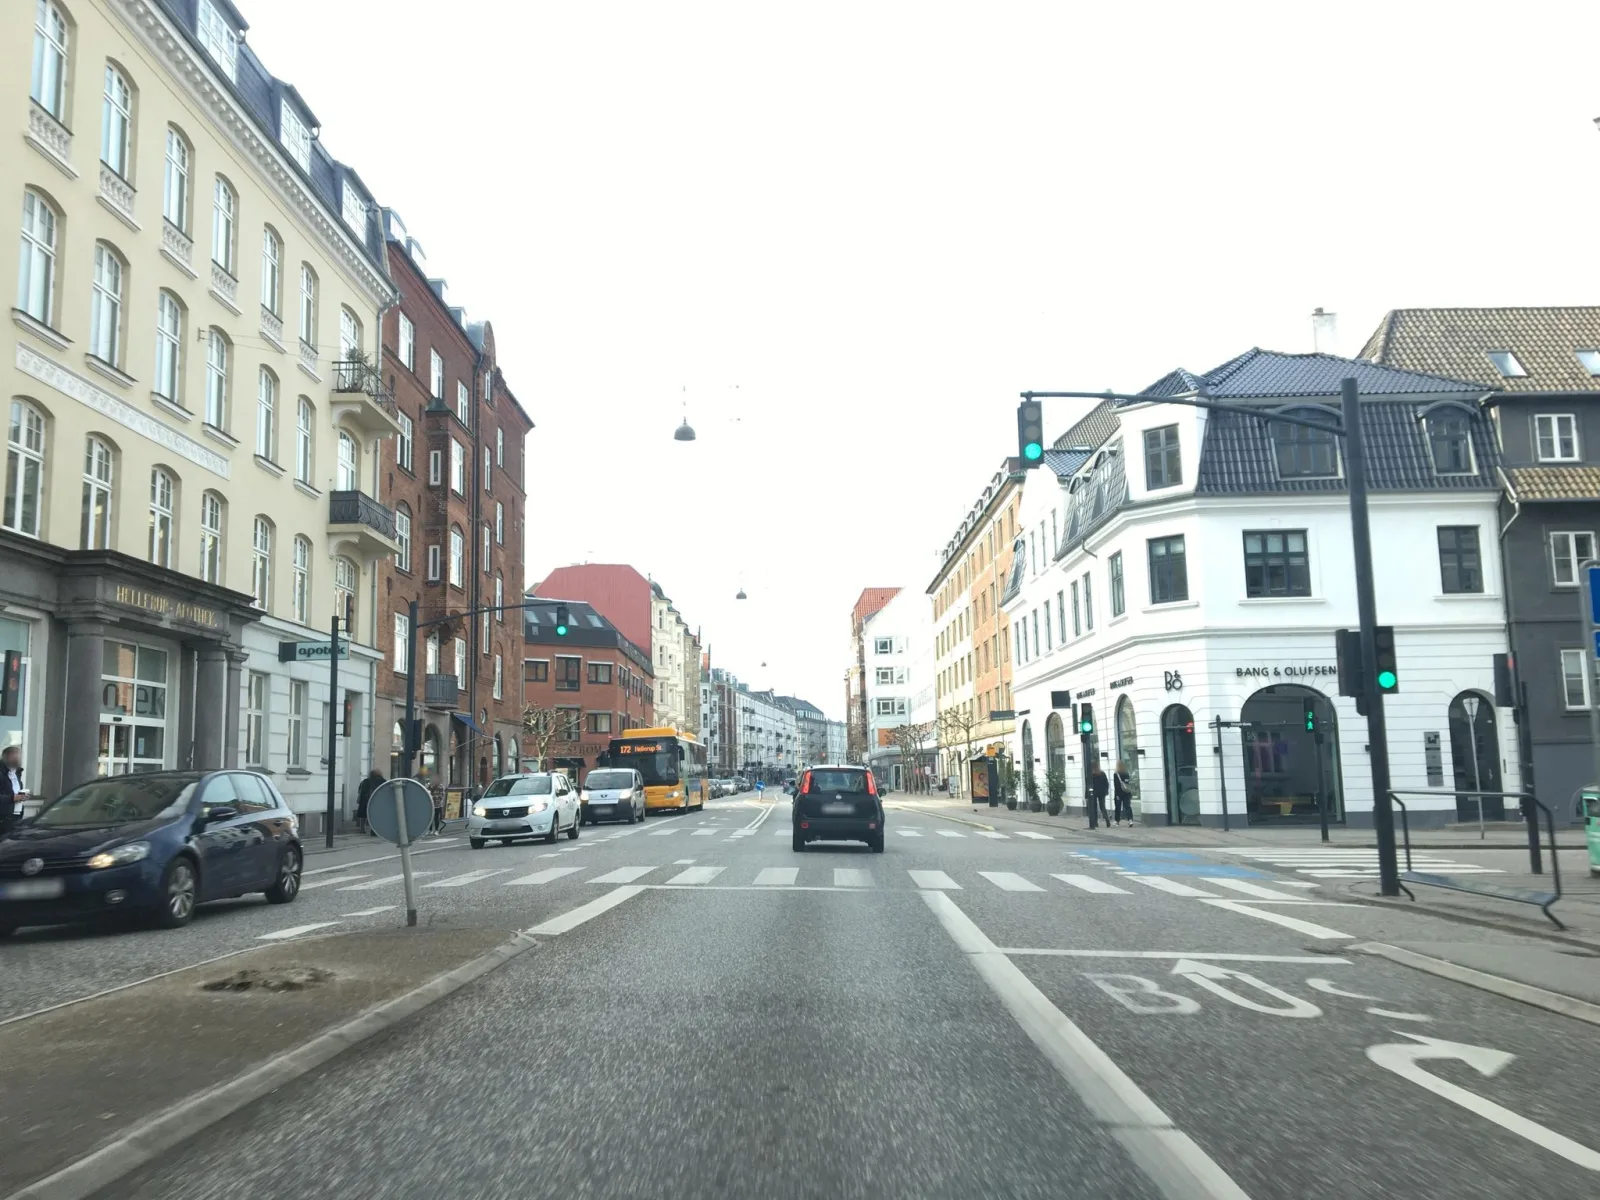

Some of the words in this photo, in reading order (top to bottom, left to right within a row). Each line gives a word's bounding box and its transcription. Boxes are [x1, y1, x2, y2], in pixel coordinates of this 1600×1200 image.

[116, 585, 169, 613] HELLERUP
[1236, 667, 1269, 677] BANG
[1273, 667, 1281, 676] &
[1284, 666, 1337, 676] OLUFSEN
[620, 746, 631, 754] 172
[1081, 969, 1433, 1020] BUS
